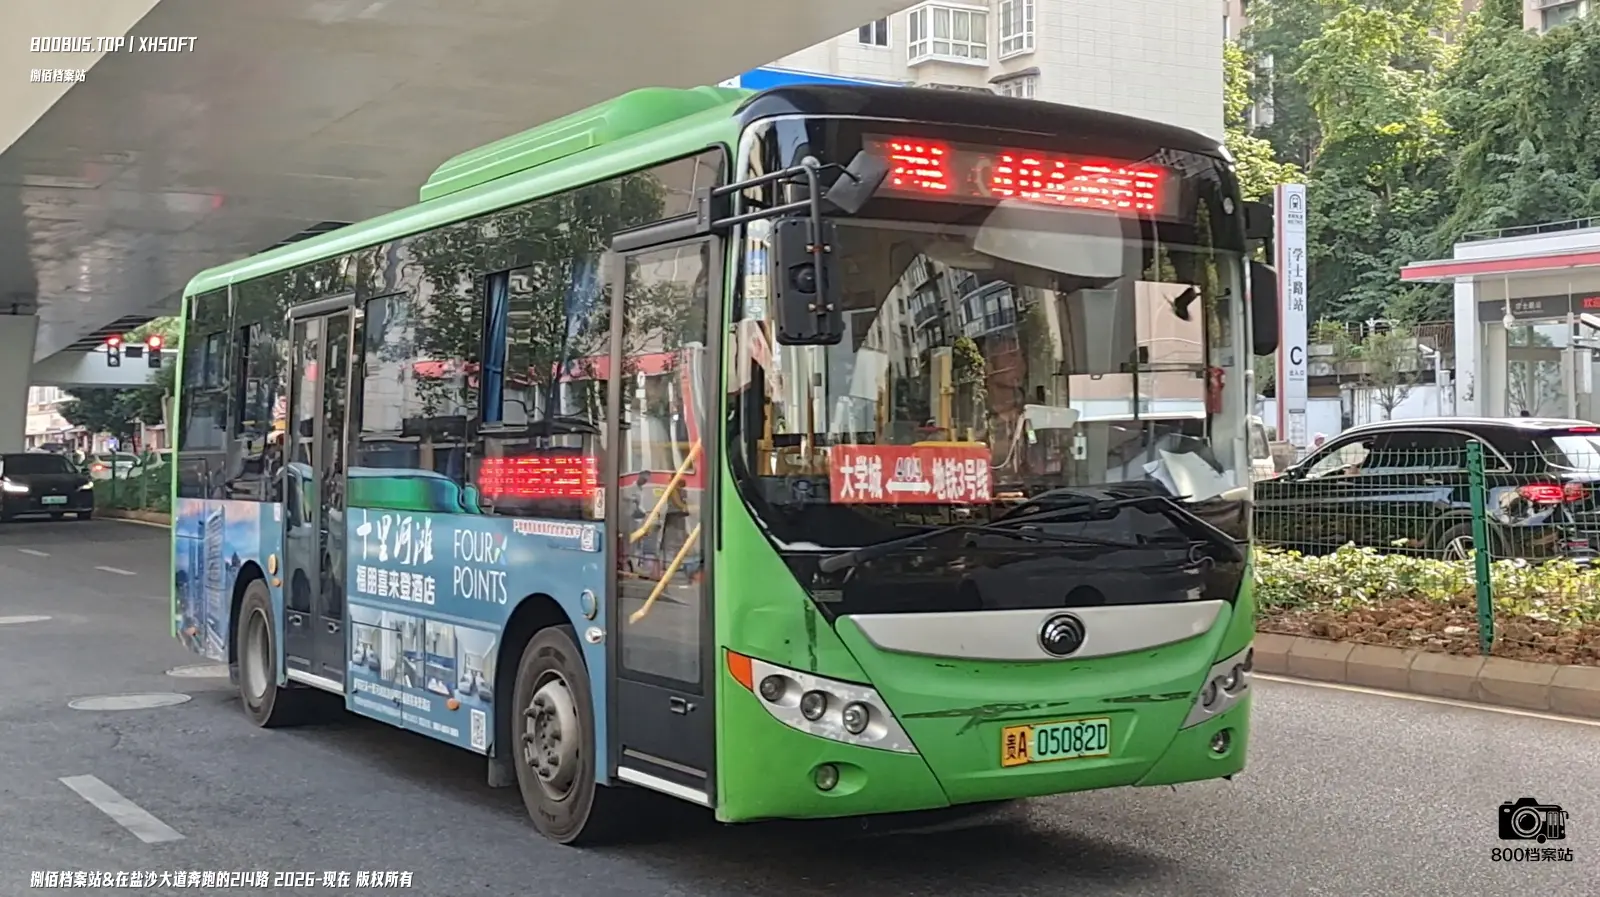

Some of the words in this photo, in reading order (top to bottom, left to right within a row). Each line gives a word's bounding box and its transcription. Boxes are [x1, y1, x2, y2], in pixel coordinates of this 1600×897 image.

[1292, 248, 1304, 312] 学士路站
[1290, 346, 1303, 365] C
[839, 455, 883, 500] 大学城
[932, 457, 990, 500] 地铁3号线
[454, 529, 495, 564] FOUR
[356, 564, 436, 606] 福朋喜来登酒店
[453, 566, 508, 605] POINTS
